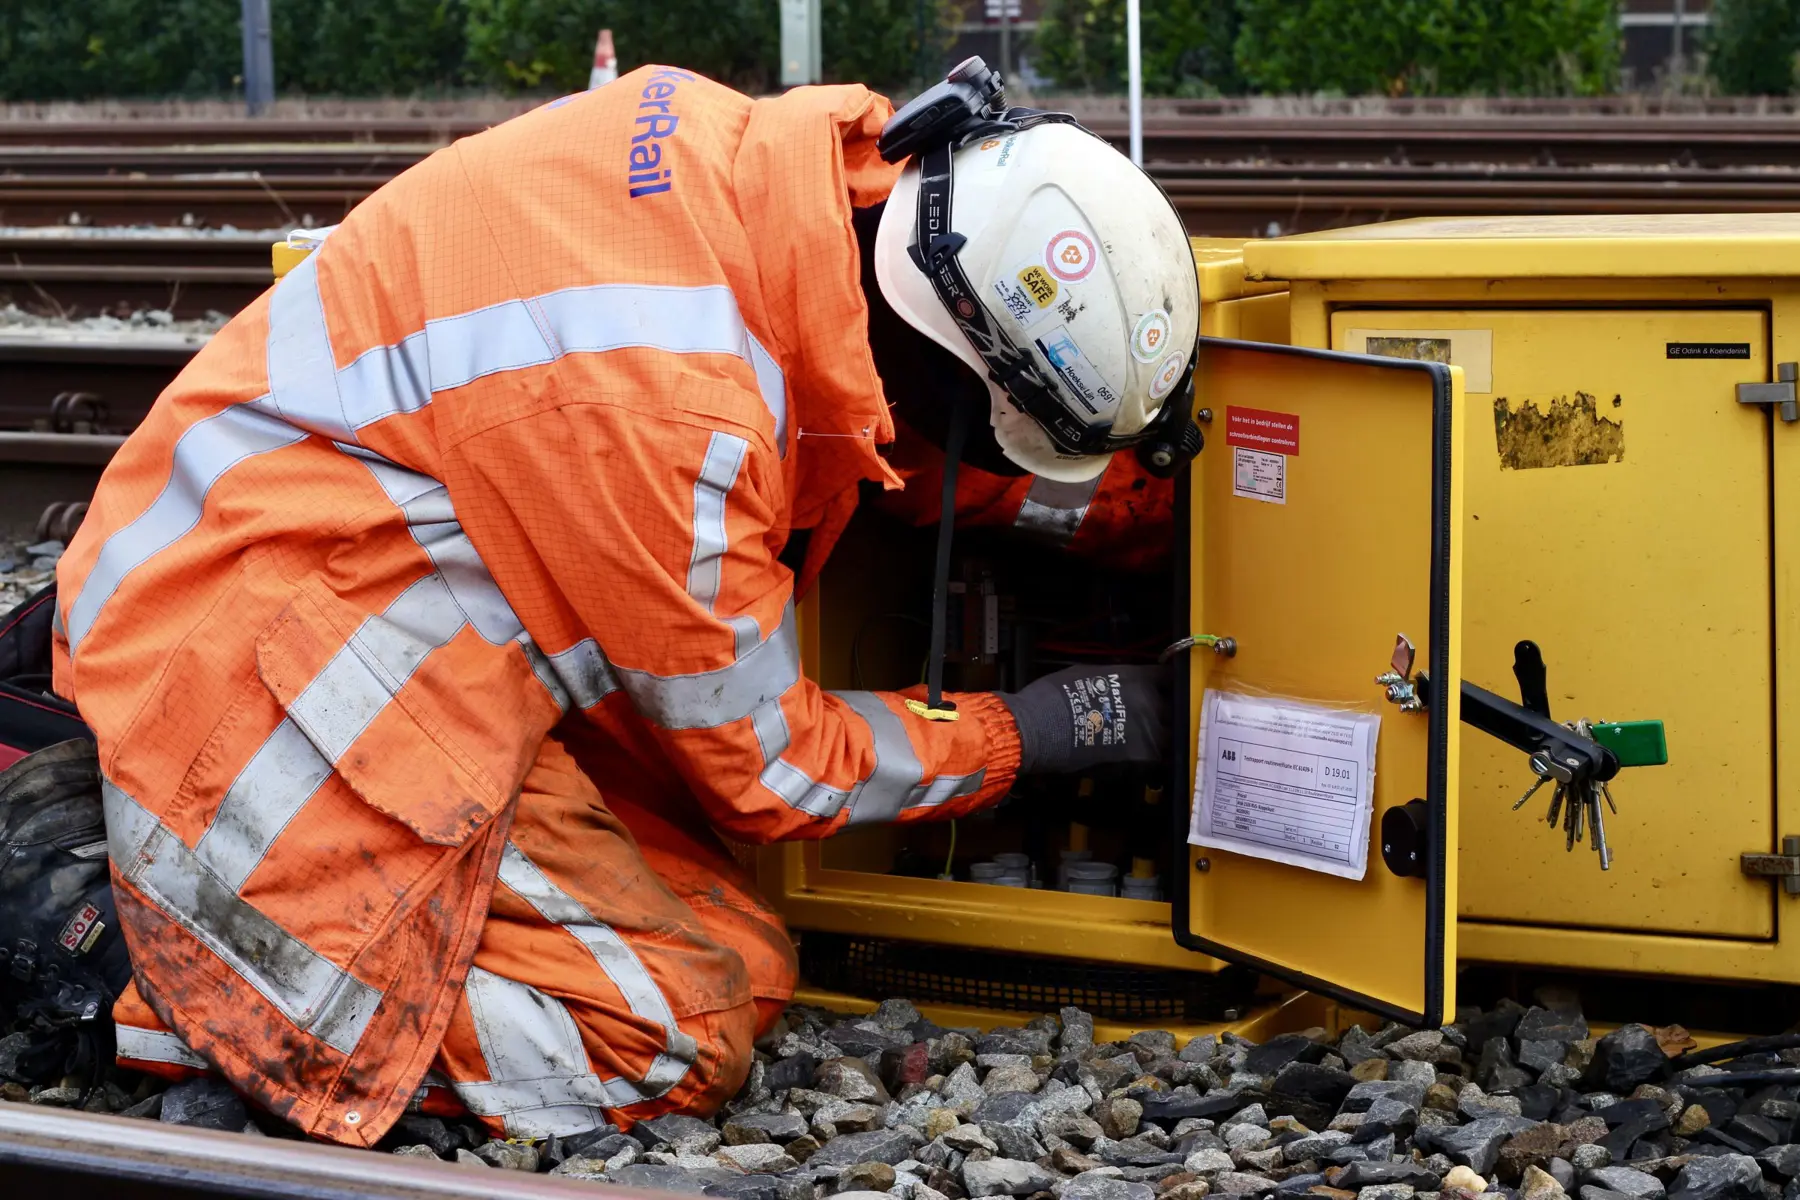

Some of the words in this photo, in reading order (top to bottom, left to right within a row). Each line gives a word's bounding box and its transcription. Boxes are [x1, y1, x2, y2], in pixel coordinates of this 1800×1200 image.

[628, 67, 696, 199] kerRail
[1023, 272, 1050, 303] SAFE
[1033, 268, 1042, 279] WE
[1040, 278, 1054, 295] WORK
[1065, 366, 1085, 390] Hoekse
[1083, 388, 1095, 402] Lijn
[1097, 386, 1115, 404] 0591
[1222, 749, 1236, 762] ABB
[1324, 767, 1330, 776] D
[1332, 767, 1350, 780] 19.01
[64, 906, 97, 948] BOS
